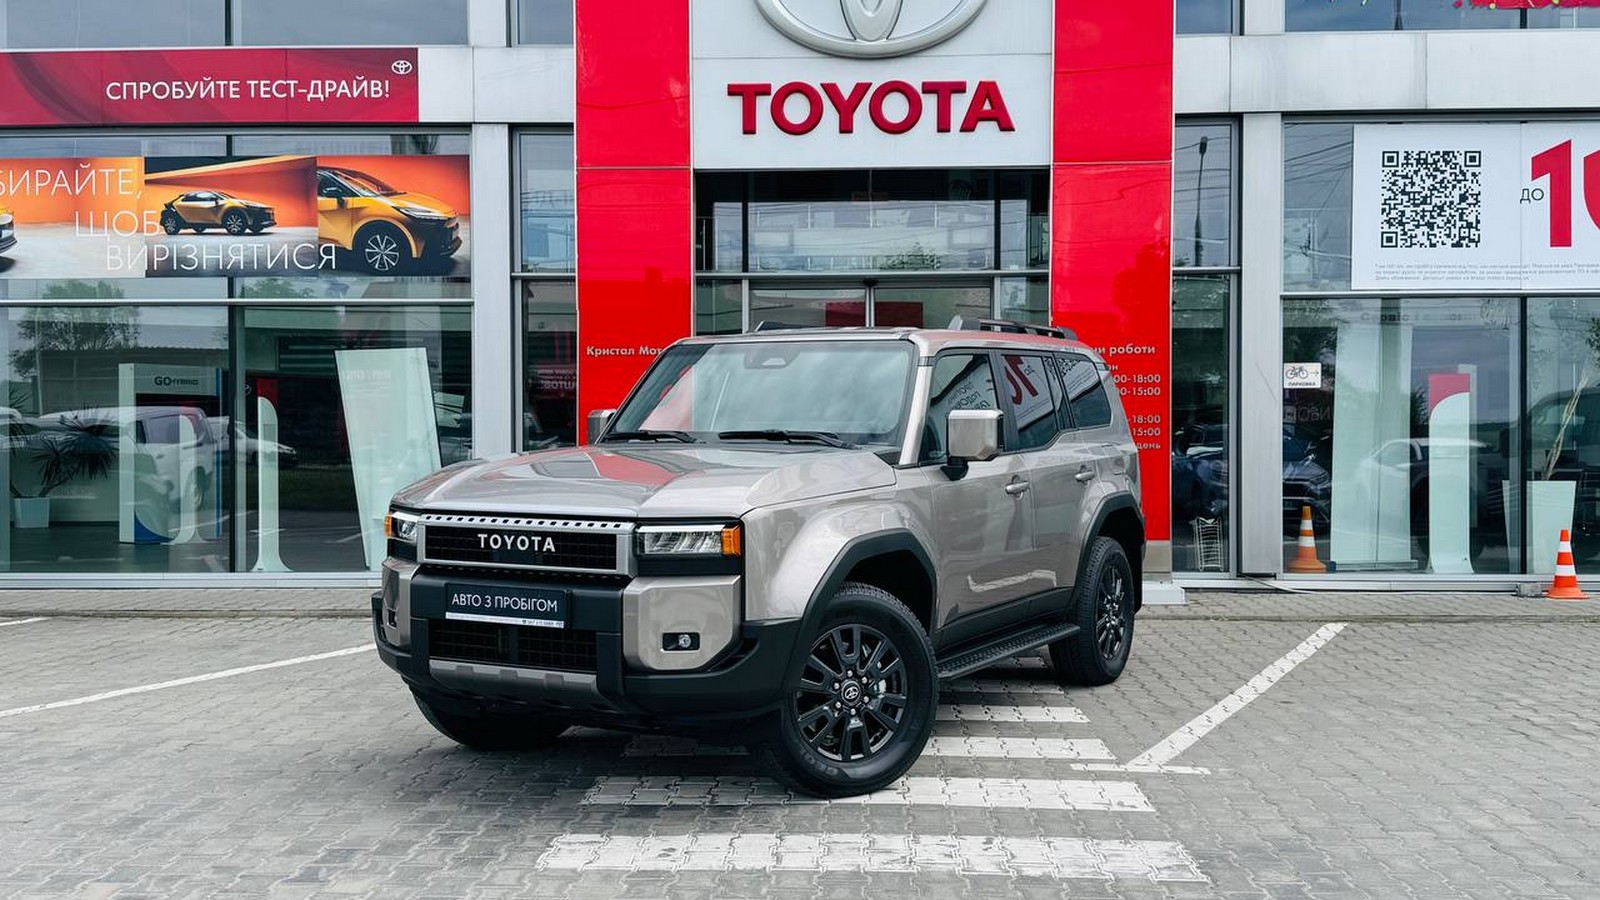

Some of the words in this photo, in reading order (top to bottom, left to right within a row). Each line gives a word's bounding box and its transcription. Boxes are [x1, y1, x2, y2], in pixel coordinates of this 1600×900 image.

[106, 77, 240, 100] СПРОБУЙТЕ
[247, 75, 391, 101] ТЕСТ-ДРАЙВ!
[727, 80, 1015, 135] TOYOTA
[0, 163, 142, 199] ИРАЙТЕ,
[75, 210, 160, 240] ЩОБ
[107, 243, 336, 270] ВИРІЗНЯТИСЯ
[586, 346, 635, 357] Кристал
[639, 346, 663, 356] Мот
[1109, 343, 1156, 356] роботи
[1114, 374, 1161, 384] 00-18:00
[1120, 387, 1161, 396] 0-15:00
[1132, 428, 1161, 437] 15:00
[477, 533, 556, 553] TOYOTA
[451, 593, 482, 607] АВТО
[494, 595, 558, 612] ПРОБІГОМ
